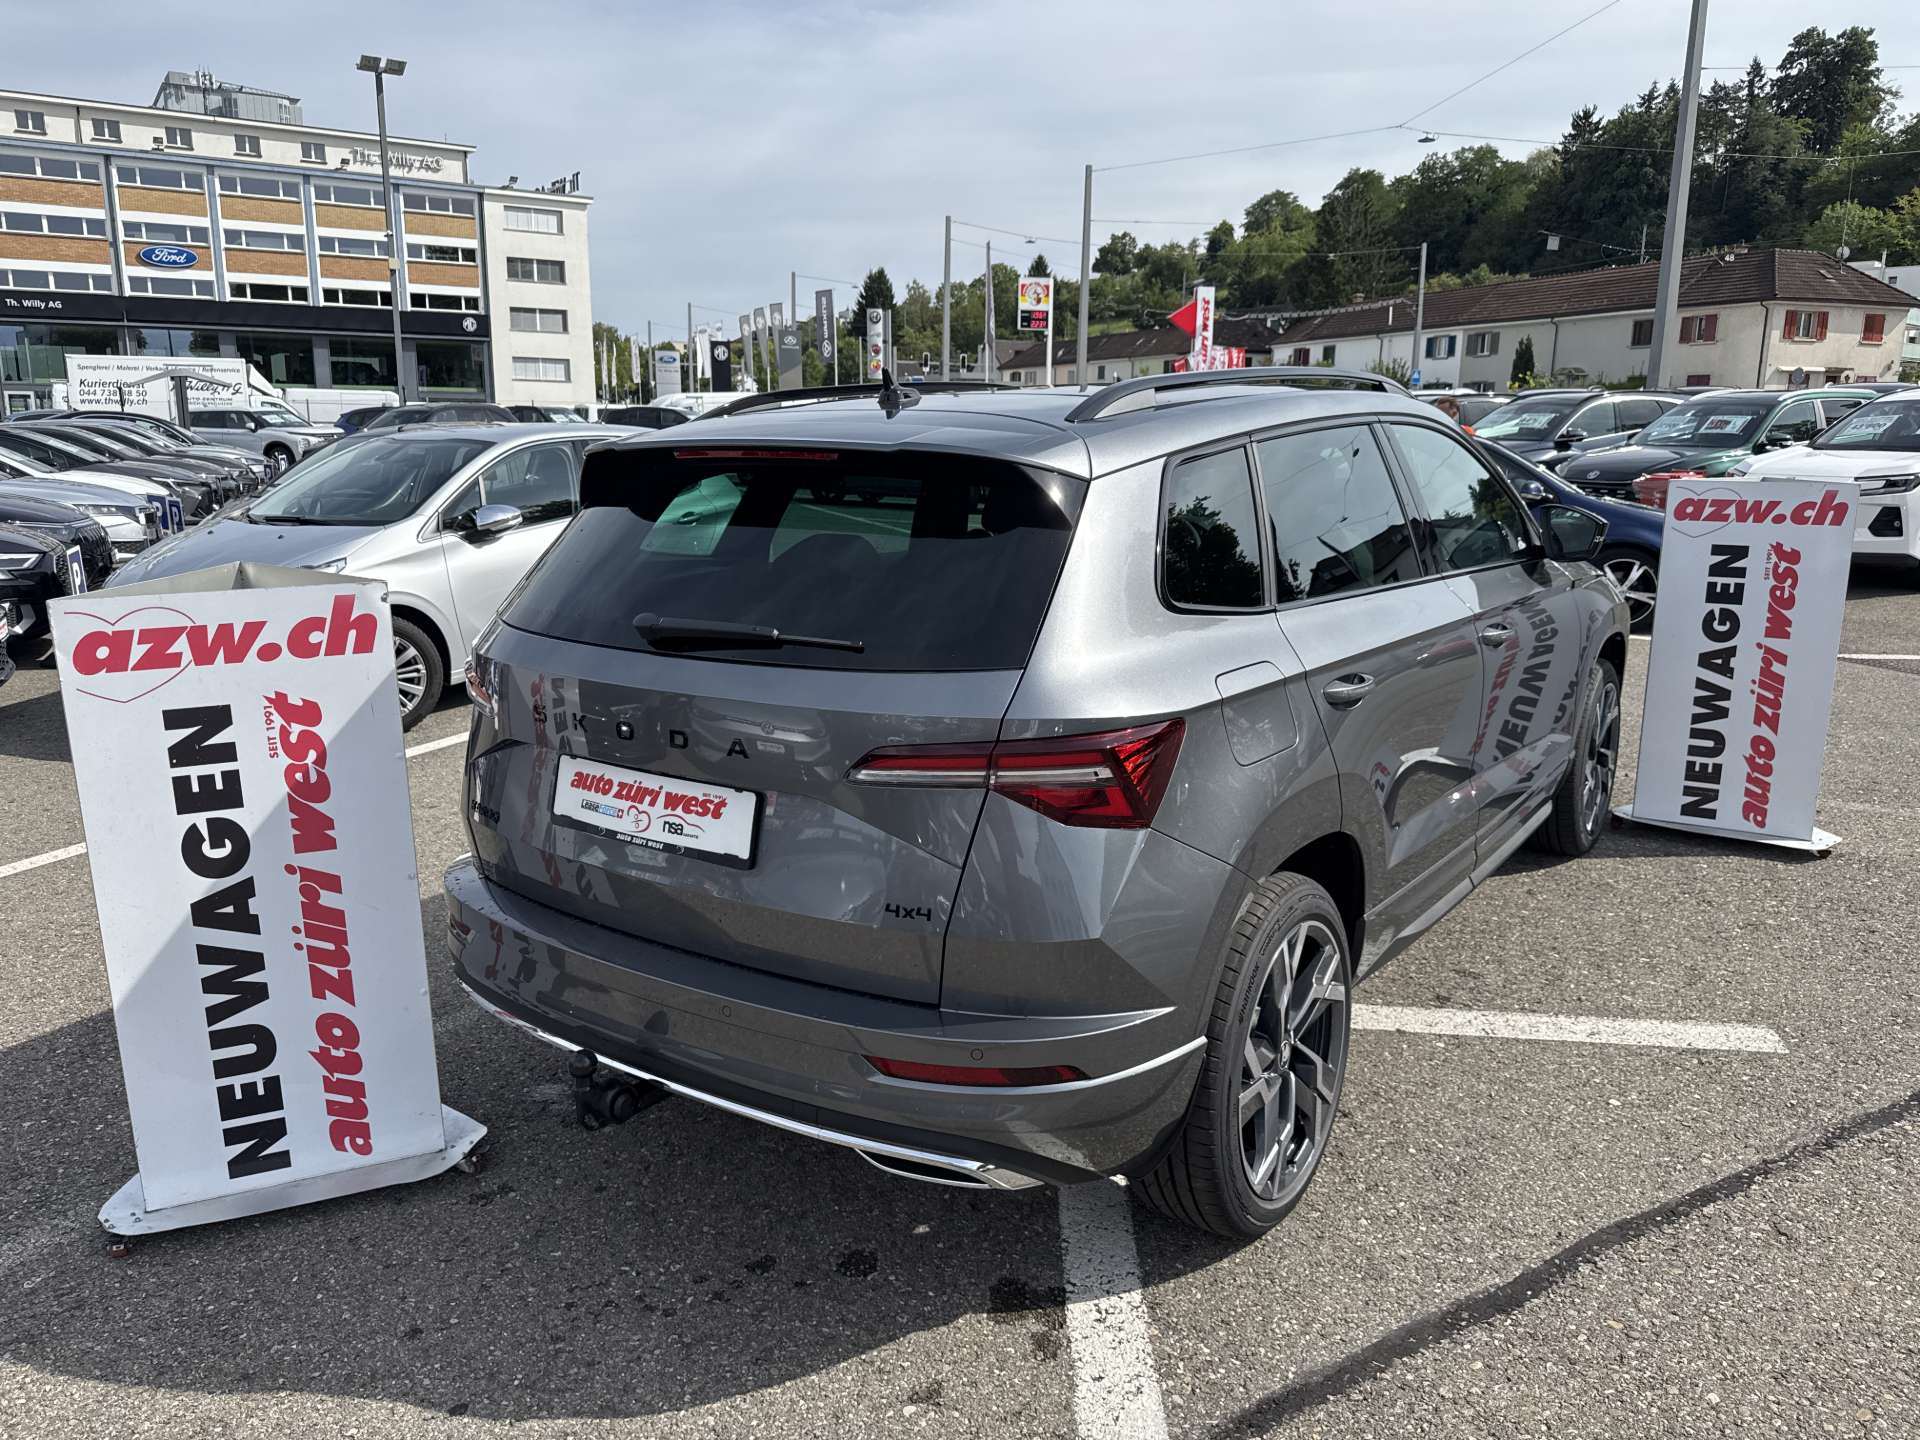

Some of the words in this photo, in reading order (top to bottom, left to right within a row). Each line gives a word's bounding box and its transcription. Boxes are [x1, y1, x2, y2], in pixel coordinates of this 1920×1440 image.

[152, 248, 187, 264] Ford
[5, 298, 20, 308] Th.
[22, 299, 46, 310] Willy
[48, 300, 62, 309] AG
[116, 364, 140, 372] Malerei
[714, 345, 729, 361] MG
[79, 389, 97, 397] 044
[1673, 490, 1850, 527] azw.ch
[1764, 541, 1802, 640] west
[72, 594, 379, 676] azw.ch
[1680, 543, 1750, 820] NEUWAGEN
[1750, 641, 1788, 736] züri
[264, 705, 275, 732] 1991
[267, 735, 279, 759] SEIT
[261, 690, 338, 855] west
[1741, 734, 1777, 829] auto
[570, 770, 614, 796] auto
[613, 779, 664, 807] züri
[663, 791, 728, 820] west
[616, 833, 632, 842] auto
[631, 836, 647, 846] züri
[647, 840, 664, 850] west
[663, 820, 683, 836] nsa
[885, 903, 931, 921] 4x4
[161, 703, 293, 1180] NEUWAGEN
[283, 863, 357, 1007] züri
[308, 1012, 373, 1157] auto
